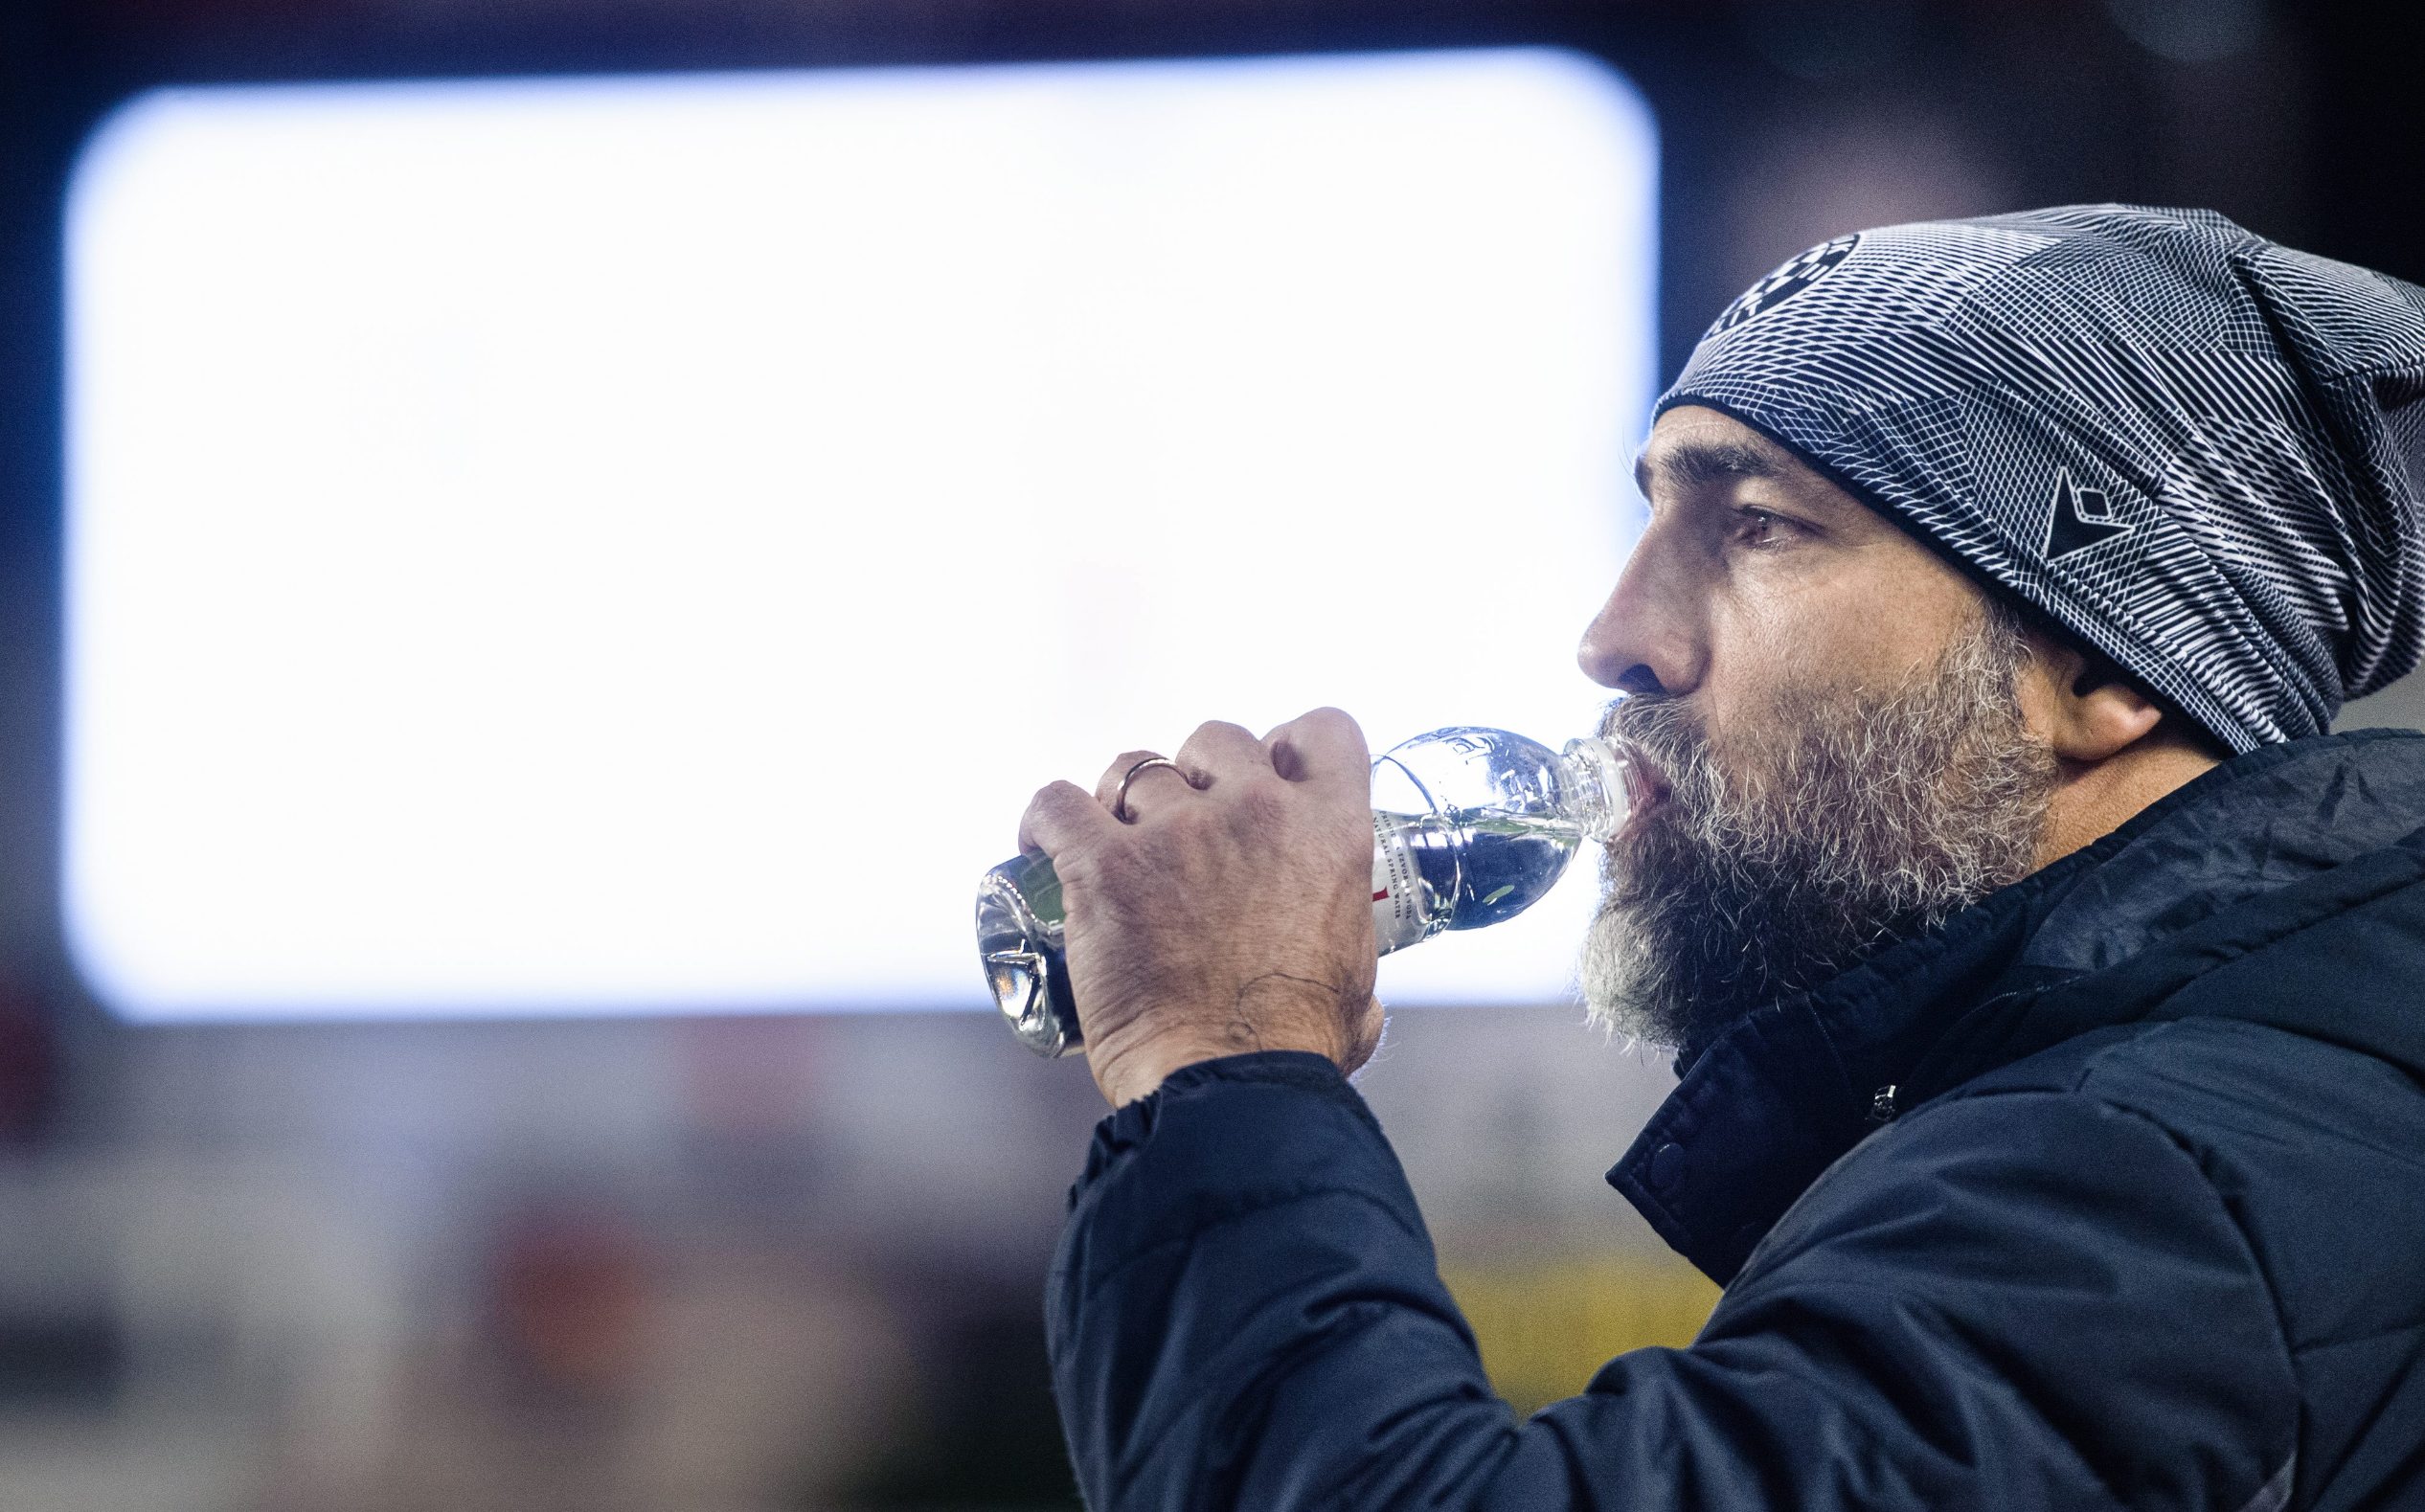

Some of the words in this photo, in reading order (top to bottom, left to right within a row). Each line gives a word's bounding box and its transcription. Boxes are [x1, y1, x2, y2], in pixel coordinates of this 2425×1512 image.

[1372, 816, 1390, 855] NATURAL
[1387, 858, 1399, 890] SPRING
[1397, 853, 1411, 897] IZVORA
